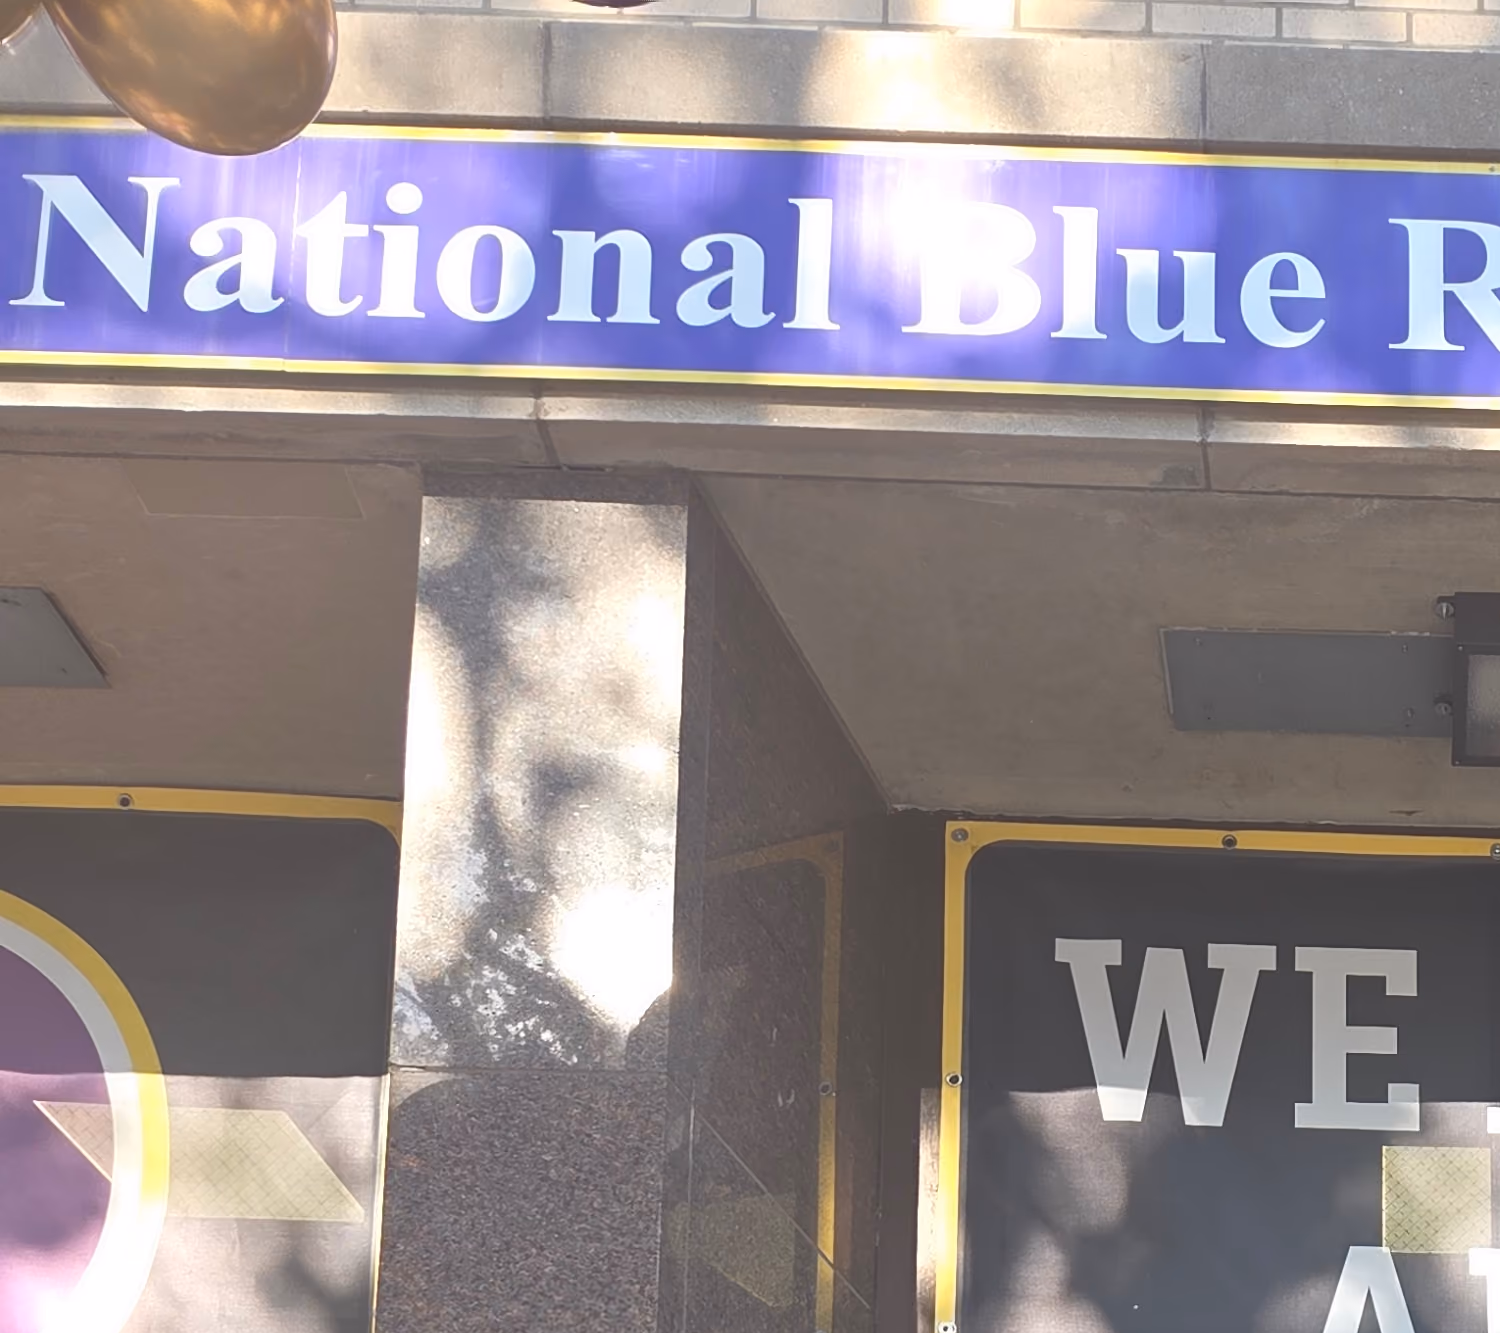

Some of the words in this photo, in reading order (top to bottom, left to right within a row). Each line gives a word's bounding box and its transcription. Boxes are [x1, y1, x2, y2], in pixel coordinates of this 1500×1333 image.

[9, 172, 842, 333] National
[900, 196, 1328, 349] Blue
[1055, 938, 1420, 1133] WE
